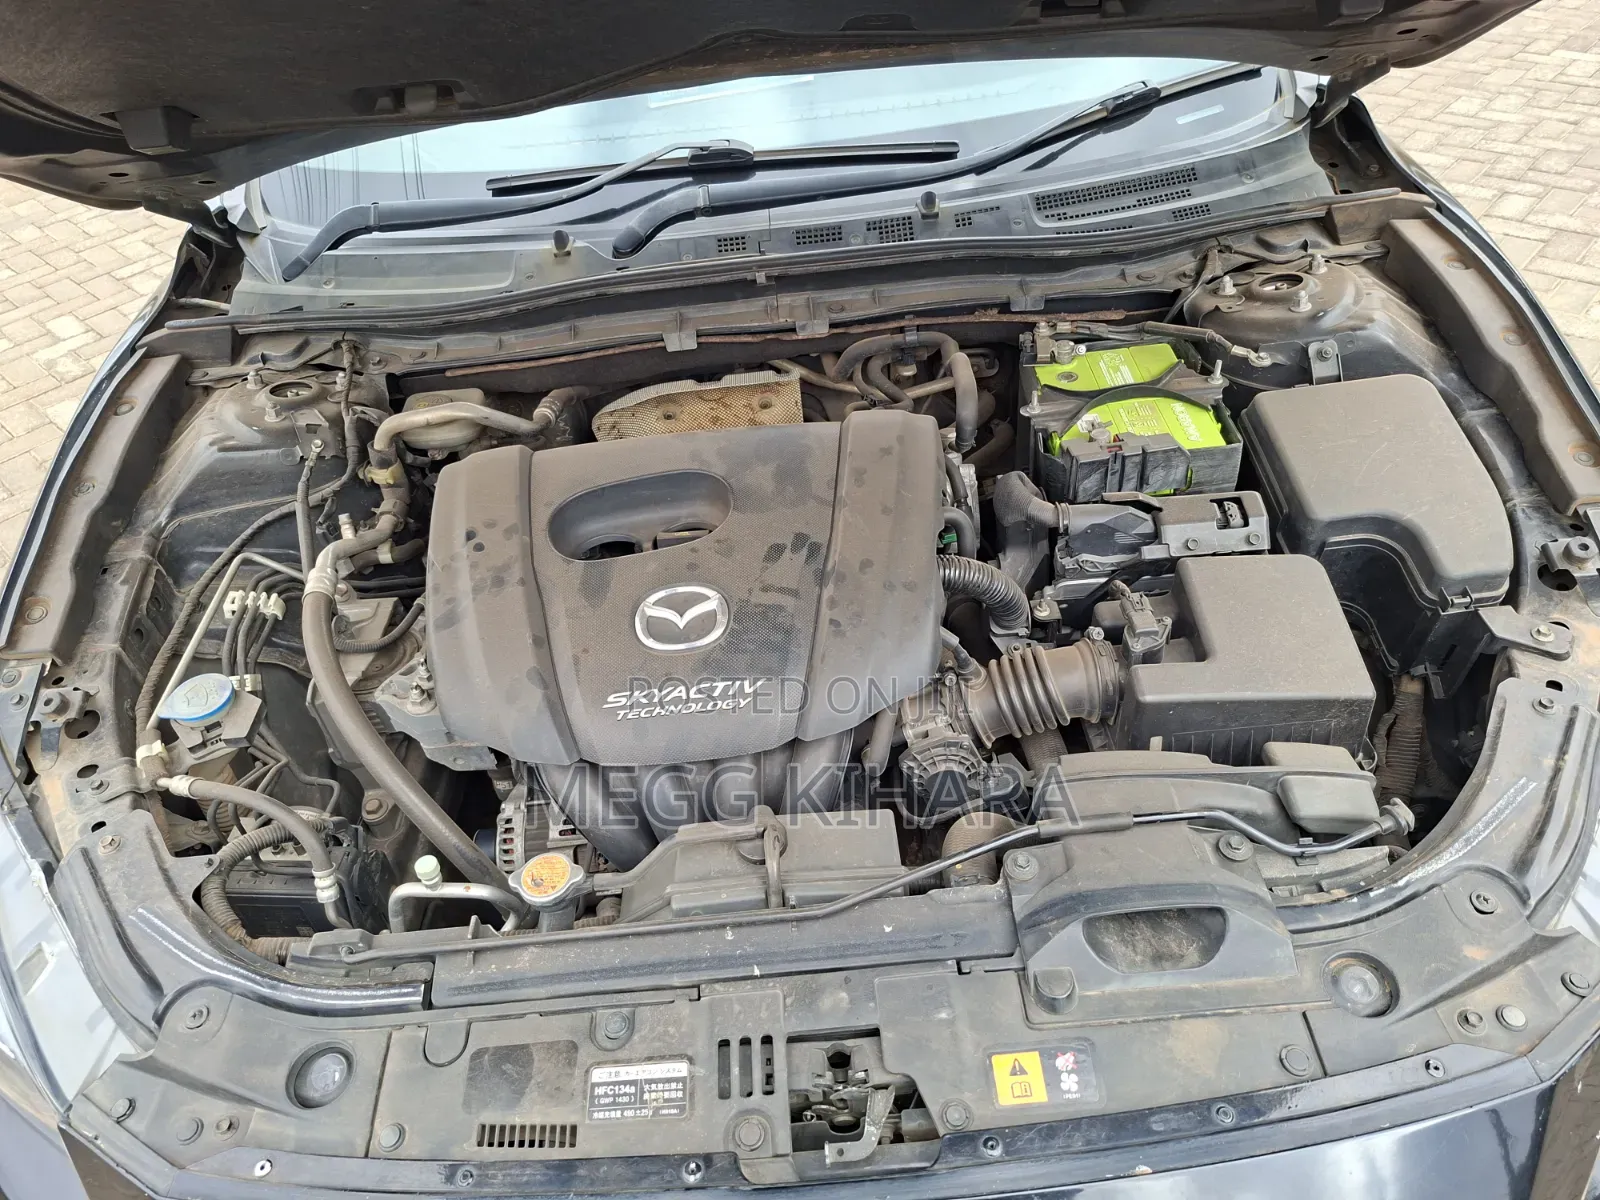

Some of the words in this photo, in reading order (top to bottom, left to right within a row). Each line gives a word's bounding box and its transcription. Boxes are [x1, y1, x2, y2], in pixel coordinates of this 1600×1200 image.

[602, 678, 767, 708] SKYACTIV
[616, 697, 753, 721] TECHNOLOGY
[594, 1085, 635, 1096] HFC134a
